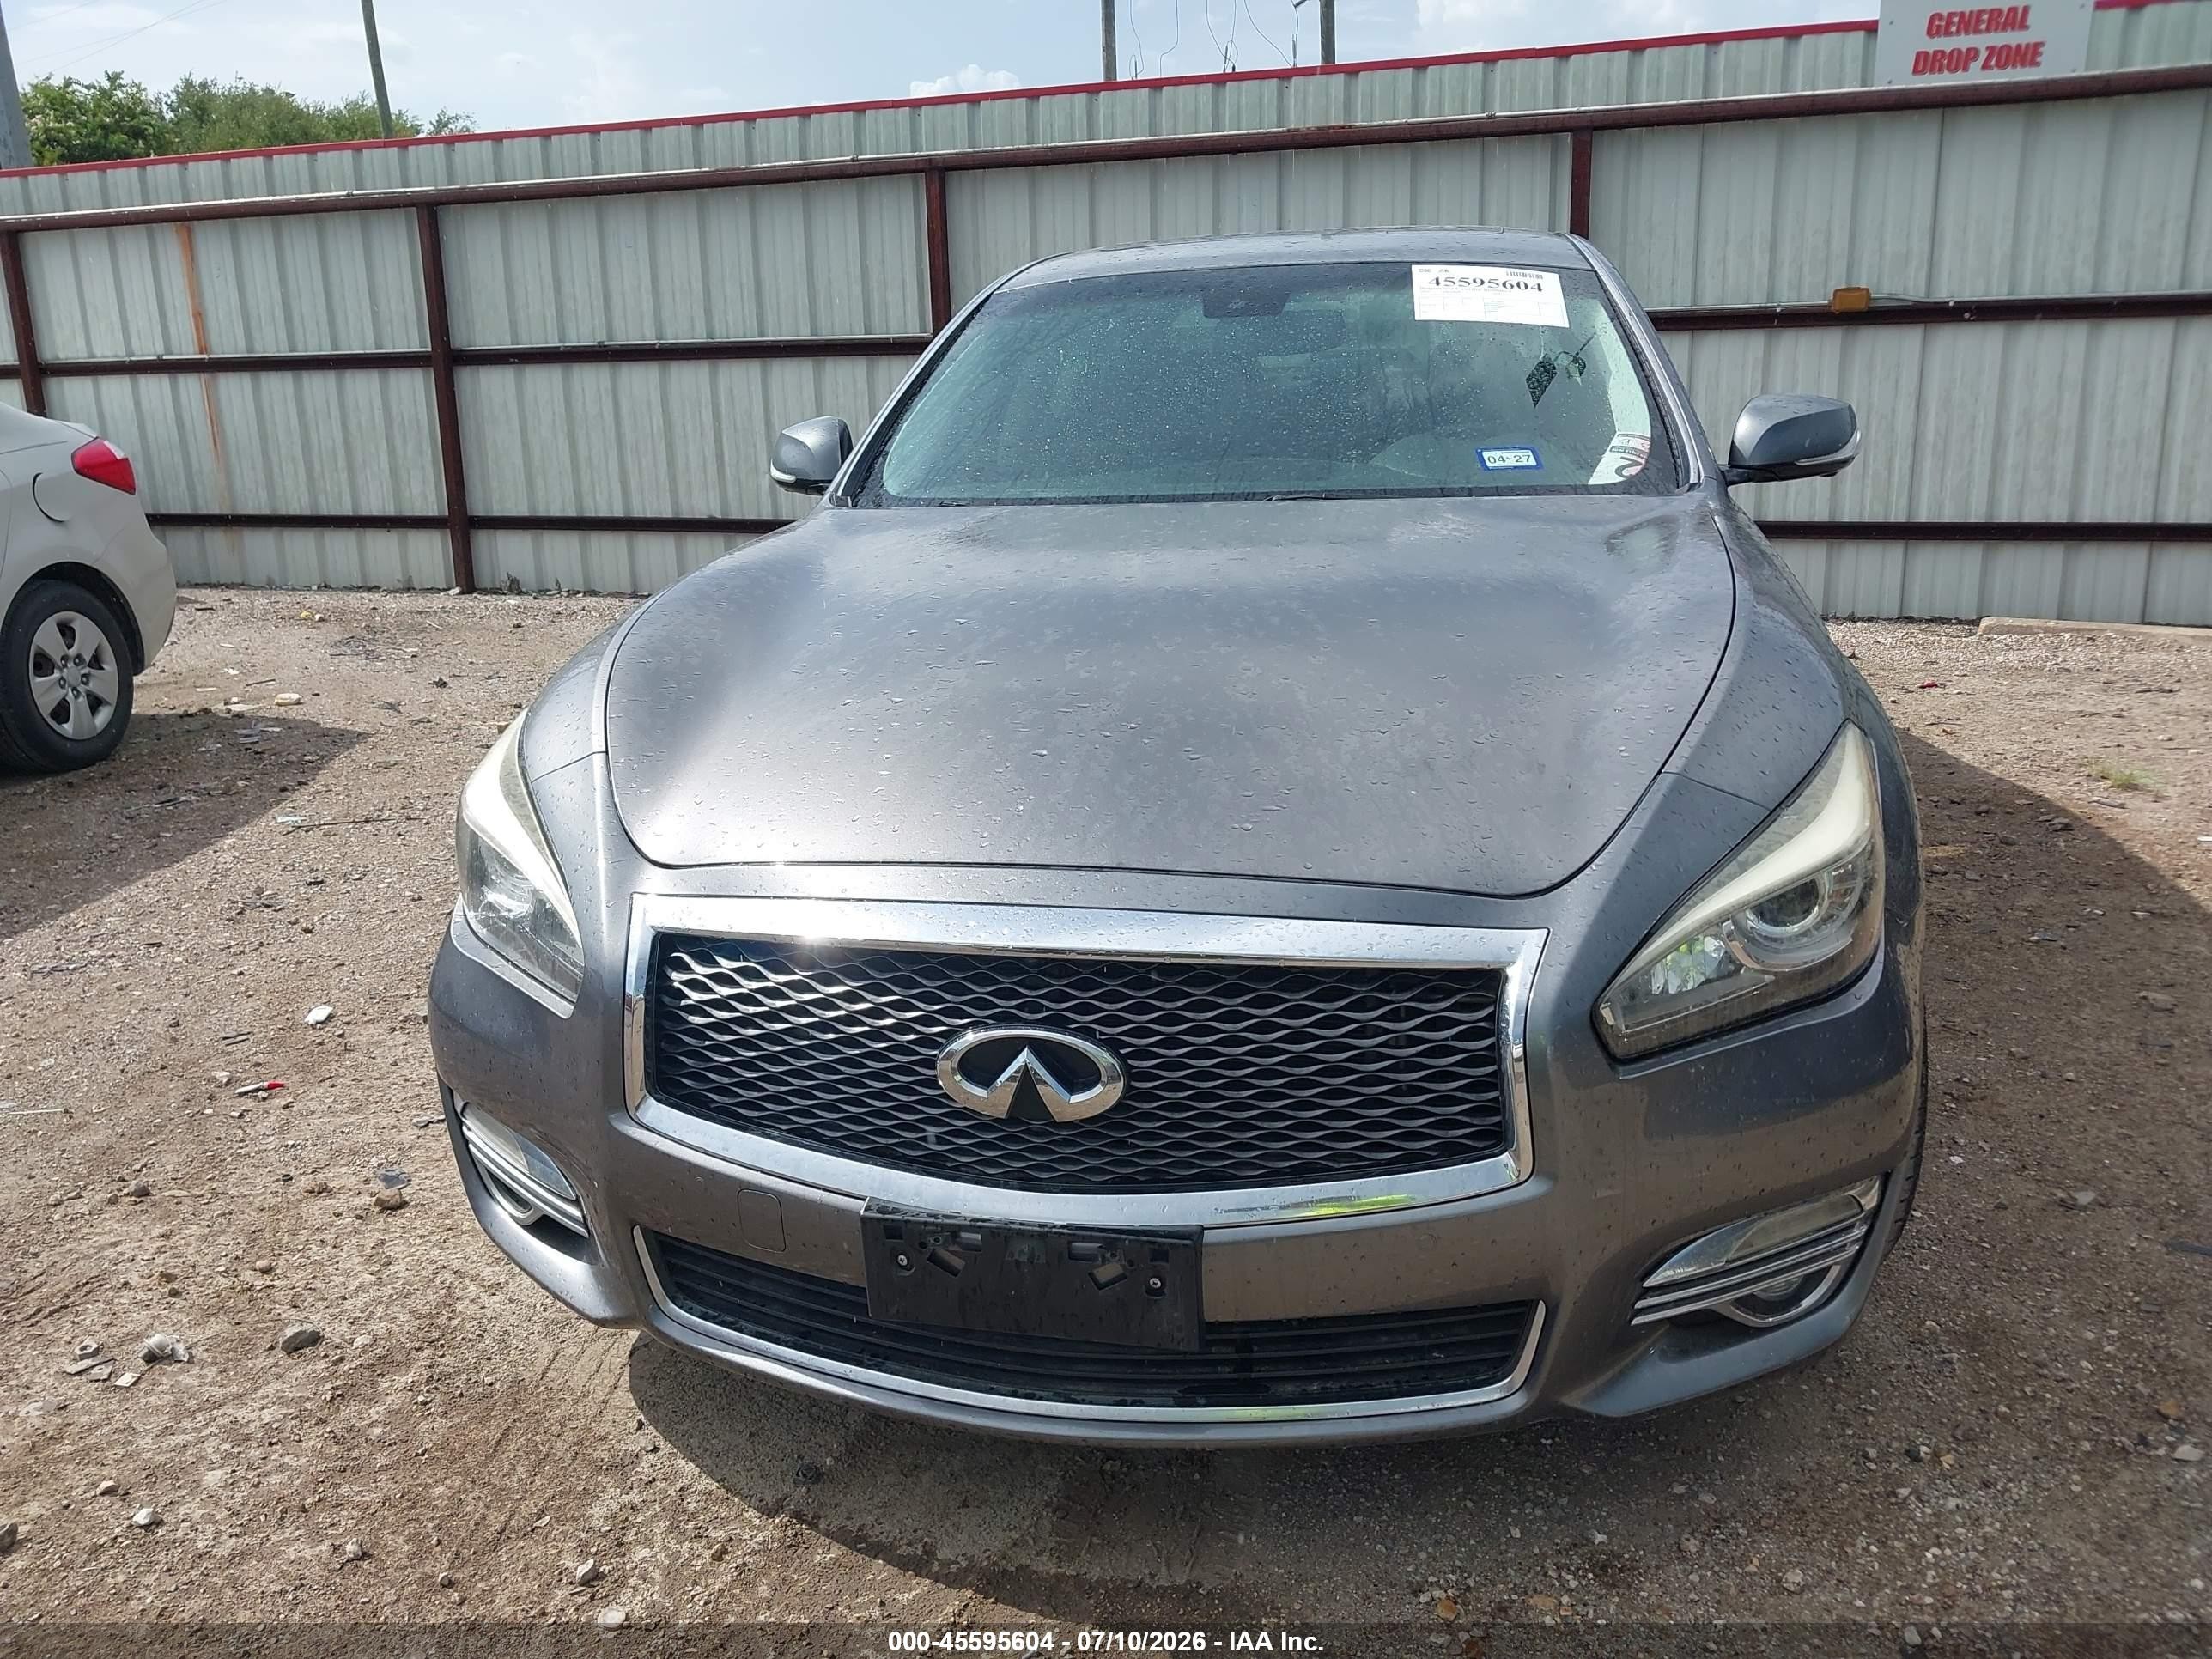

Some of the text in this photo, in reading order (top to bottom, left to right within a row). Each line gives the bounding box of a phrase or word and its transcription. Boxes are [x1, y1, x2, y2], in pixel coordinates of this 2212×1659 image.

[1926, 5, 2030, 39] GENERAL
[1911, 41, 2046, 76] DROP ZONE
[1428, 276, 1544, 293] 45595604
